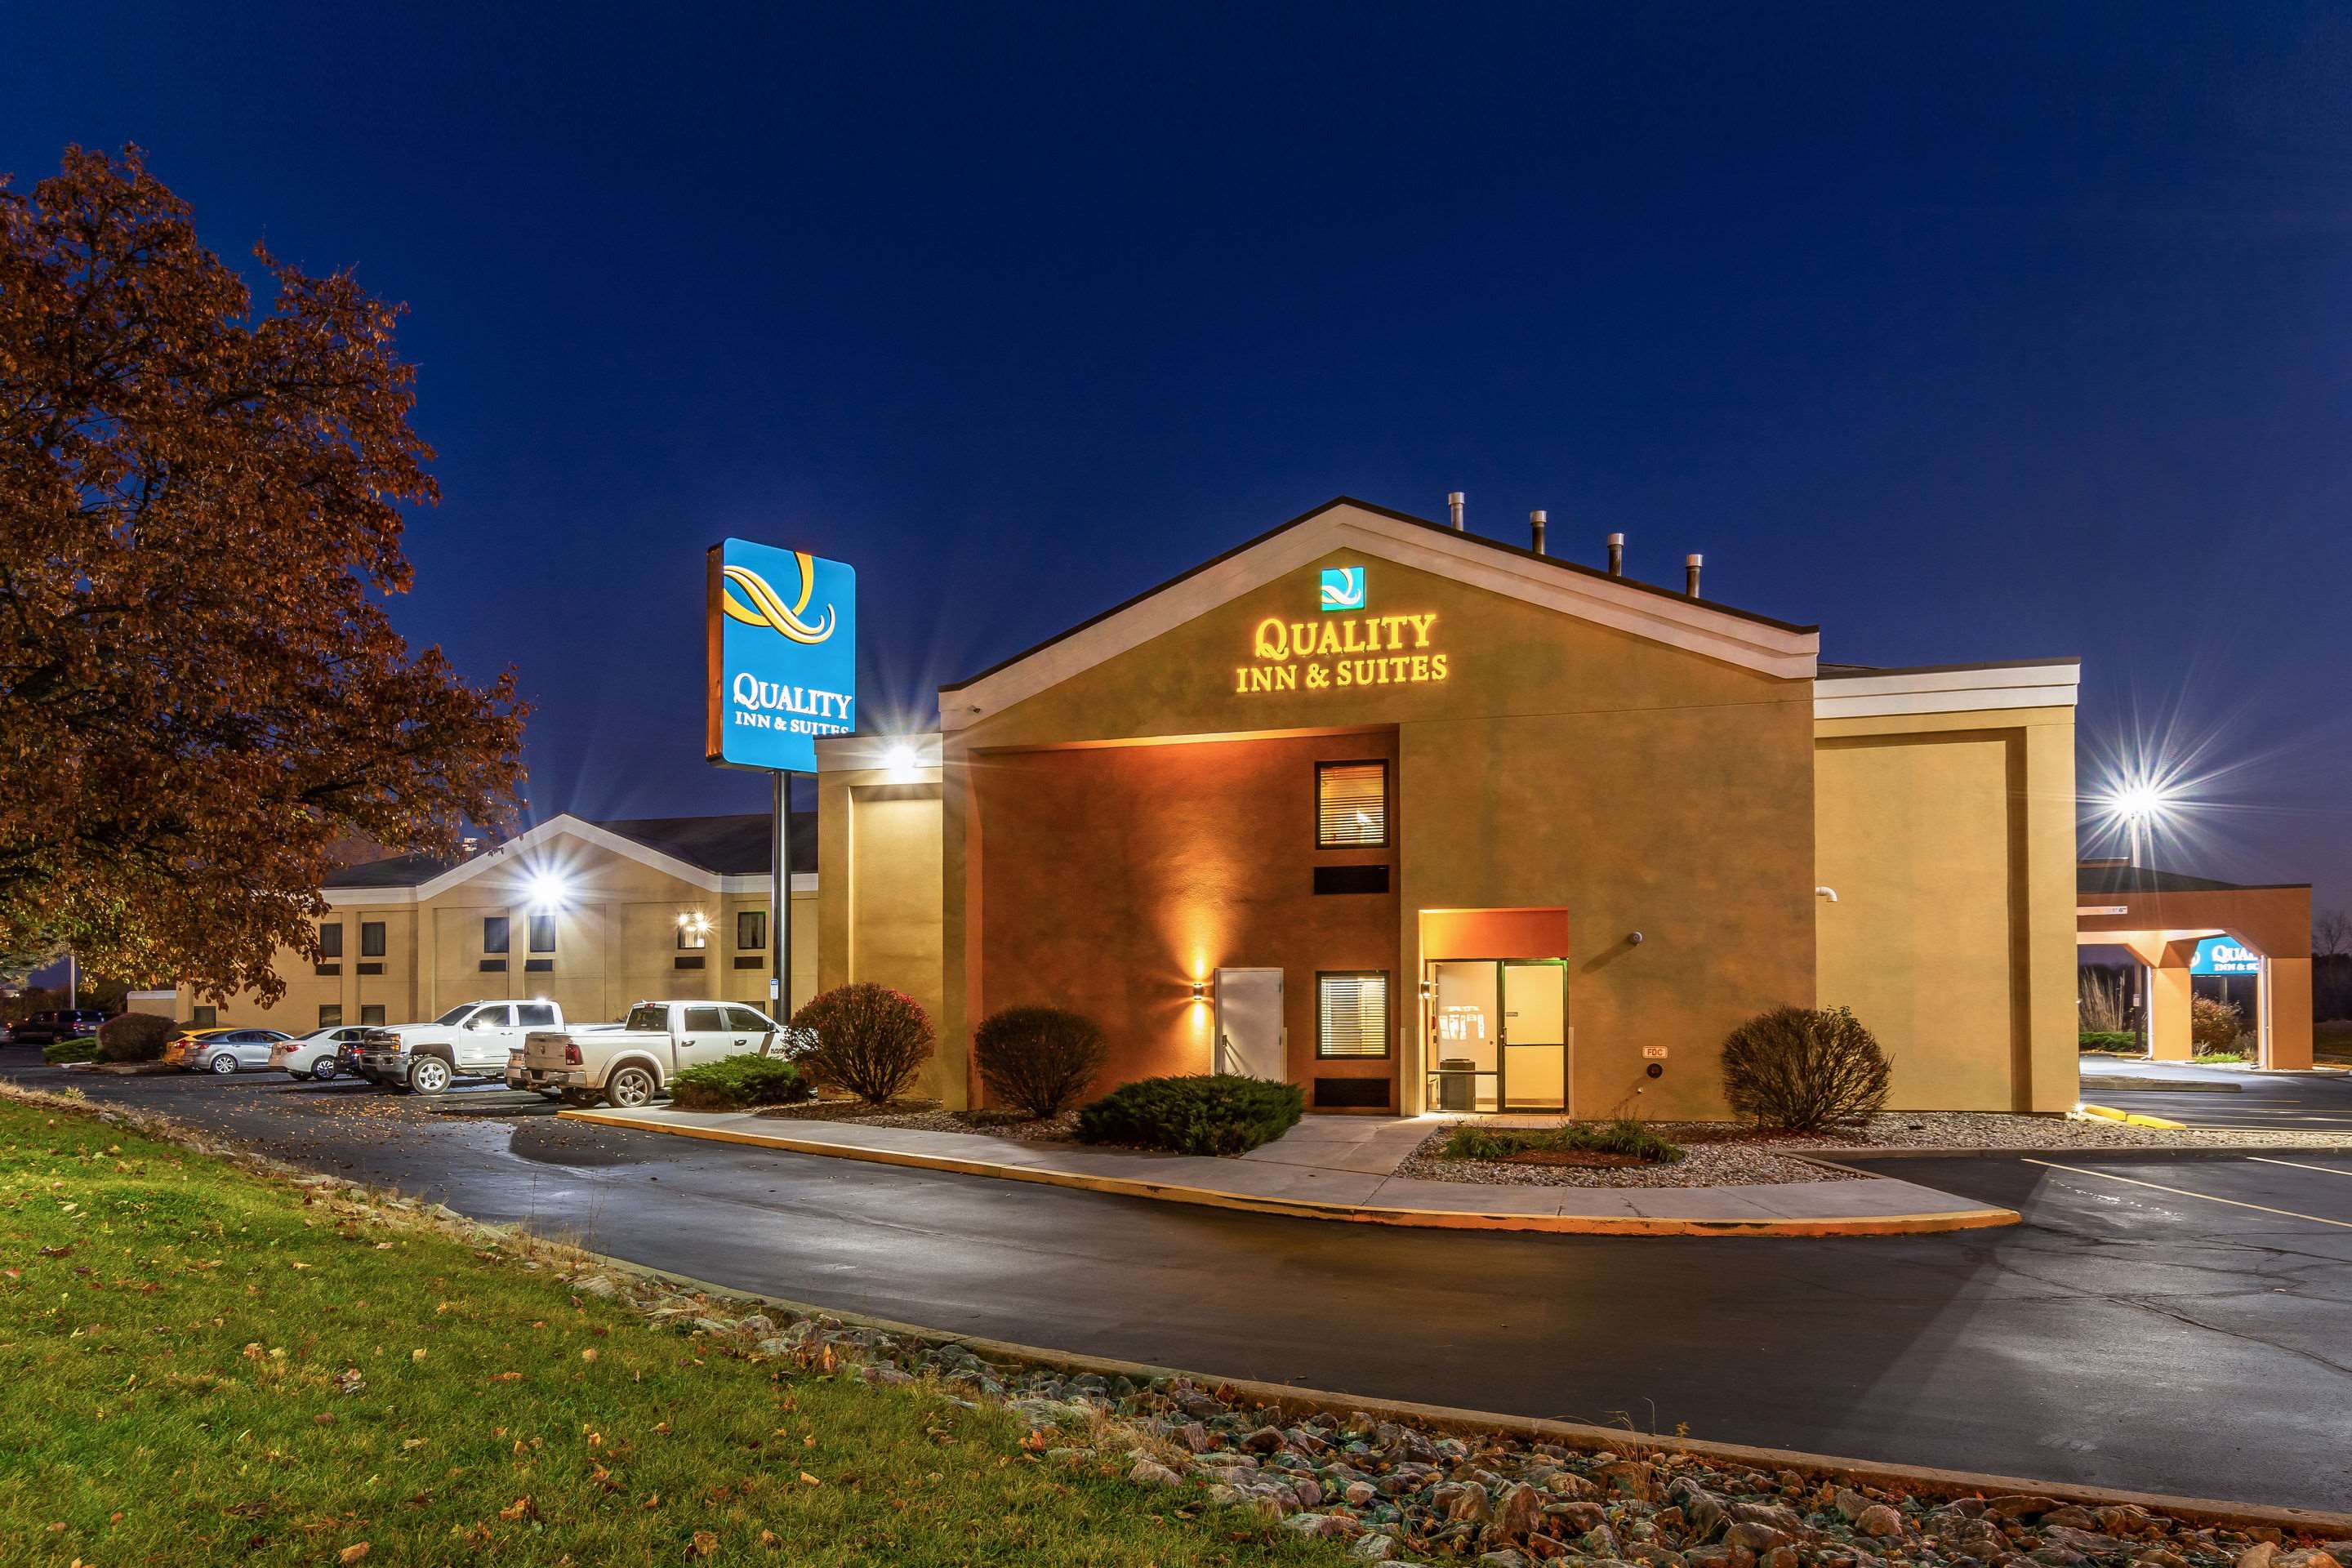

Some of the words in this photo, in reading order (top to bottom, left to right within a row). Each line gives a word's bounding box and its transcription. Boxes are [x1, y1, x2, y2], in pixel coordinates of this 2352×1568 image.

[1255, 614, 1437, 661] QUALITY
[1236, 665, 1297, 693] INN
[1307, 663, 1330, 688] &
[1337, 654, 1448, 686] SUITES
[733, 672, 853, 719] QUALITY
[735, 711, 770, 728] INN
[774, 717, 786, 731] &
